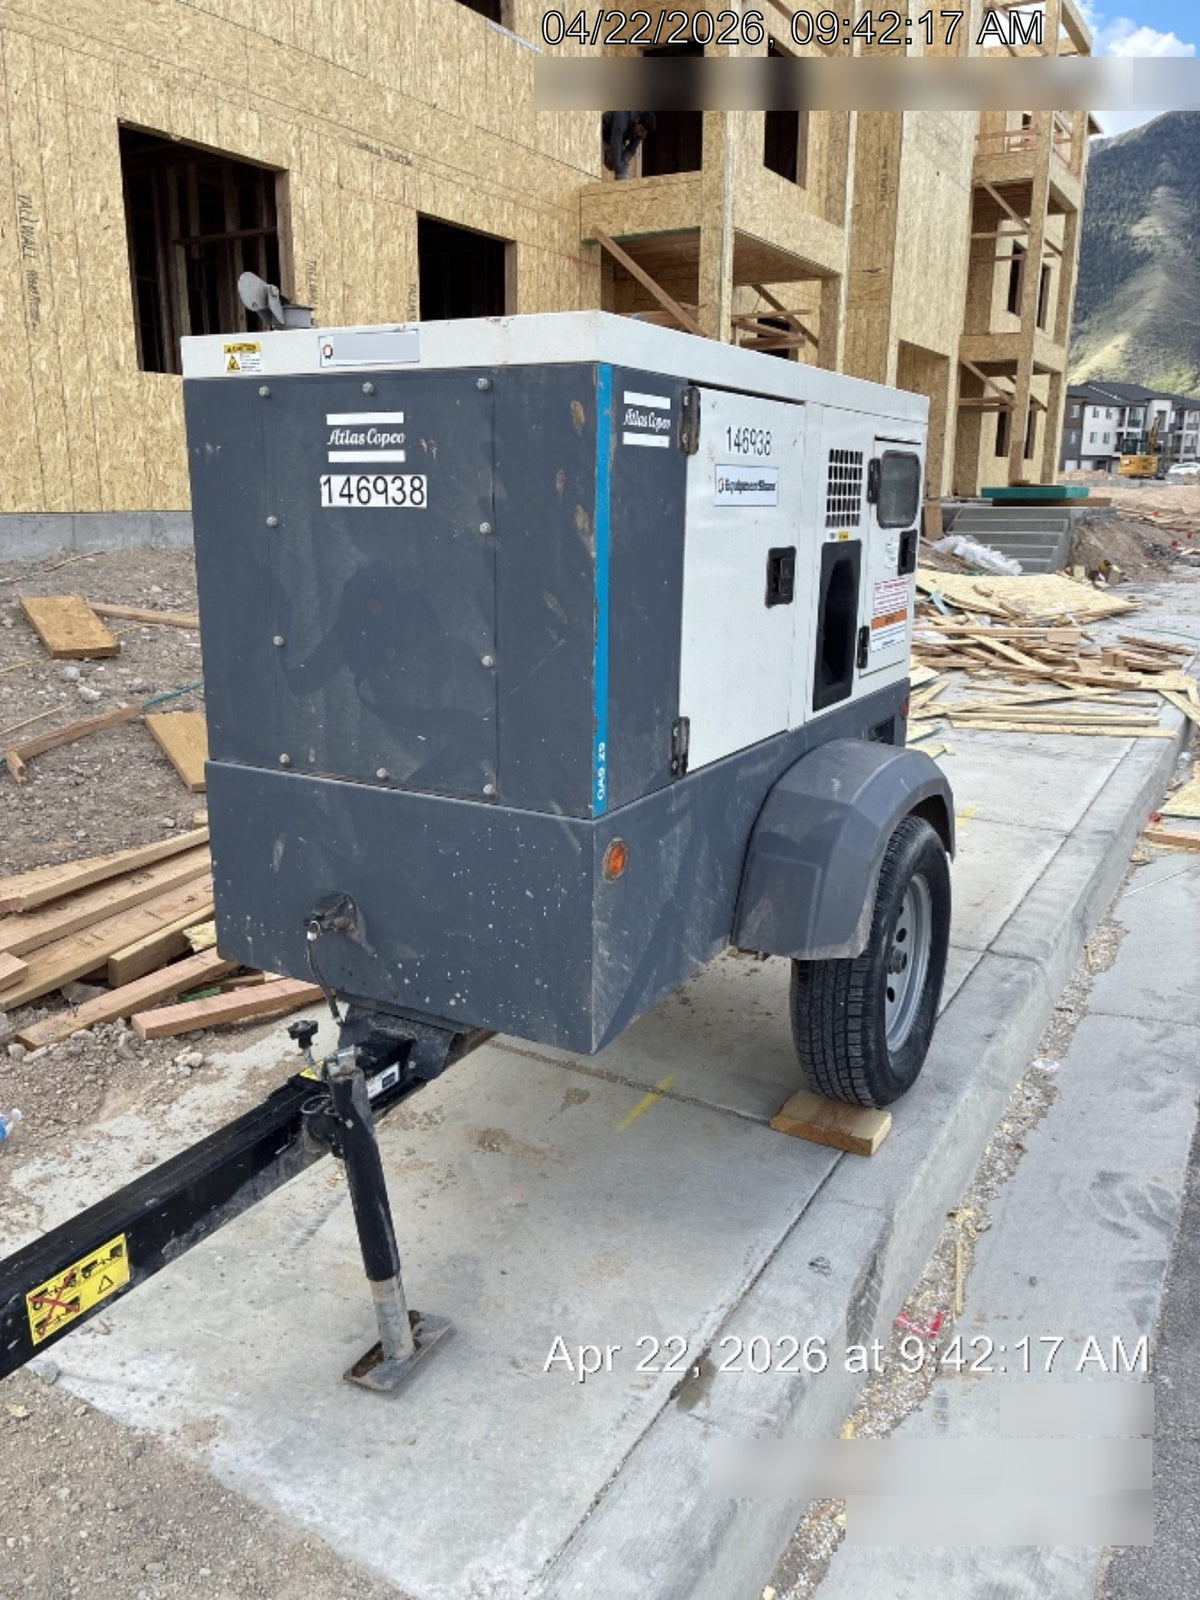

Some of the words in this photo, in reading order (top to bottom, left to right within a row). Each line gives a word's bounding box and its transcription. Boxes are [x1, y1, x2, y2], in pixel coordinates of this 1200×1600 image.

[622, 408, 648, 428] Atlas
[648, 411, 672, 433] Copco
[326, 428, 366, 446] Atlas
[367, 427, 406, 448] Copco
[726, 426, 773, 456] 146938
[322, 475, 425, 506] 146938
